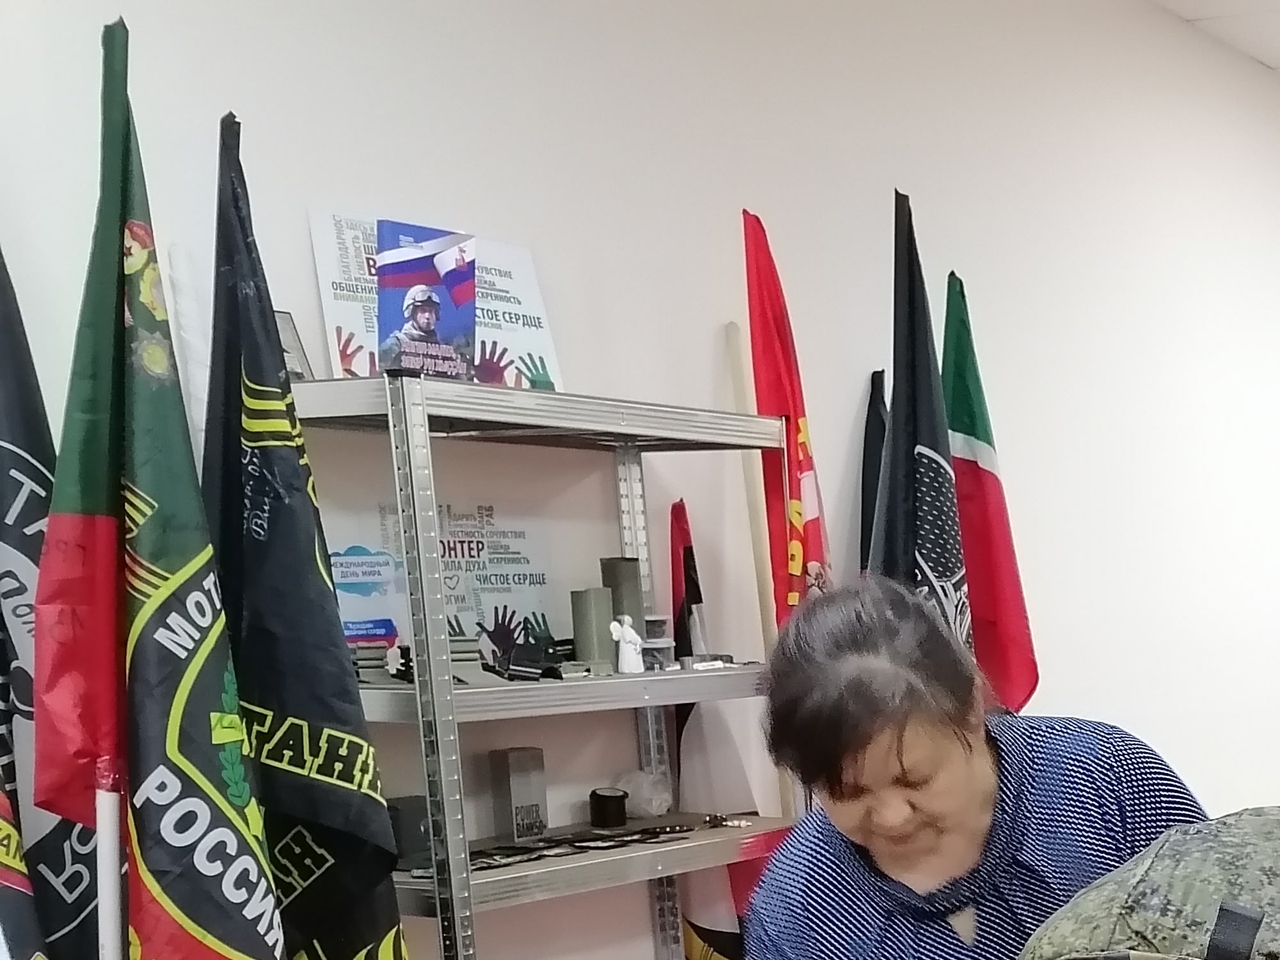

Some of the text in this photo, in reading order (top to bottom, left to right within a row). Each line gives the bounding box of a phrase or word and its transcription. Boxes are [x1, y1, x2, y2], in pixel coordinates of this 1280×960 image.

[476, 264, 513, 280] ЧУВСТВИЕ
[476, 290, 522, 306] СКРЕННОСТЬ
[362, 305, 376, 334] ТЕПЛО
[475, 306, 544, 330] СТОЕ СЕРДЦЕ
[439, 539, 485, 559] ОНТЕР
[340, 570, 383, 579] ДЕНЬ МИРА
[465, 560, 488, 573] ДУХА
[475, 573, 547, 587] ЧИСТОЕ СЕРДЦЕ
[153, 569, 222, 660] МОТ
